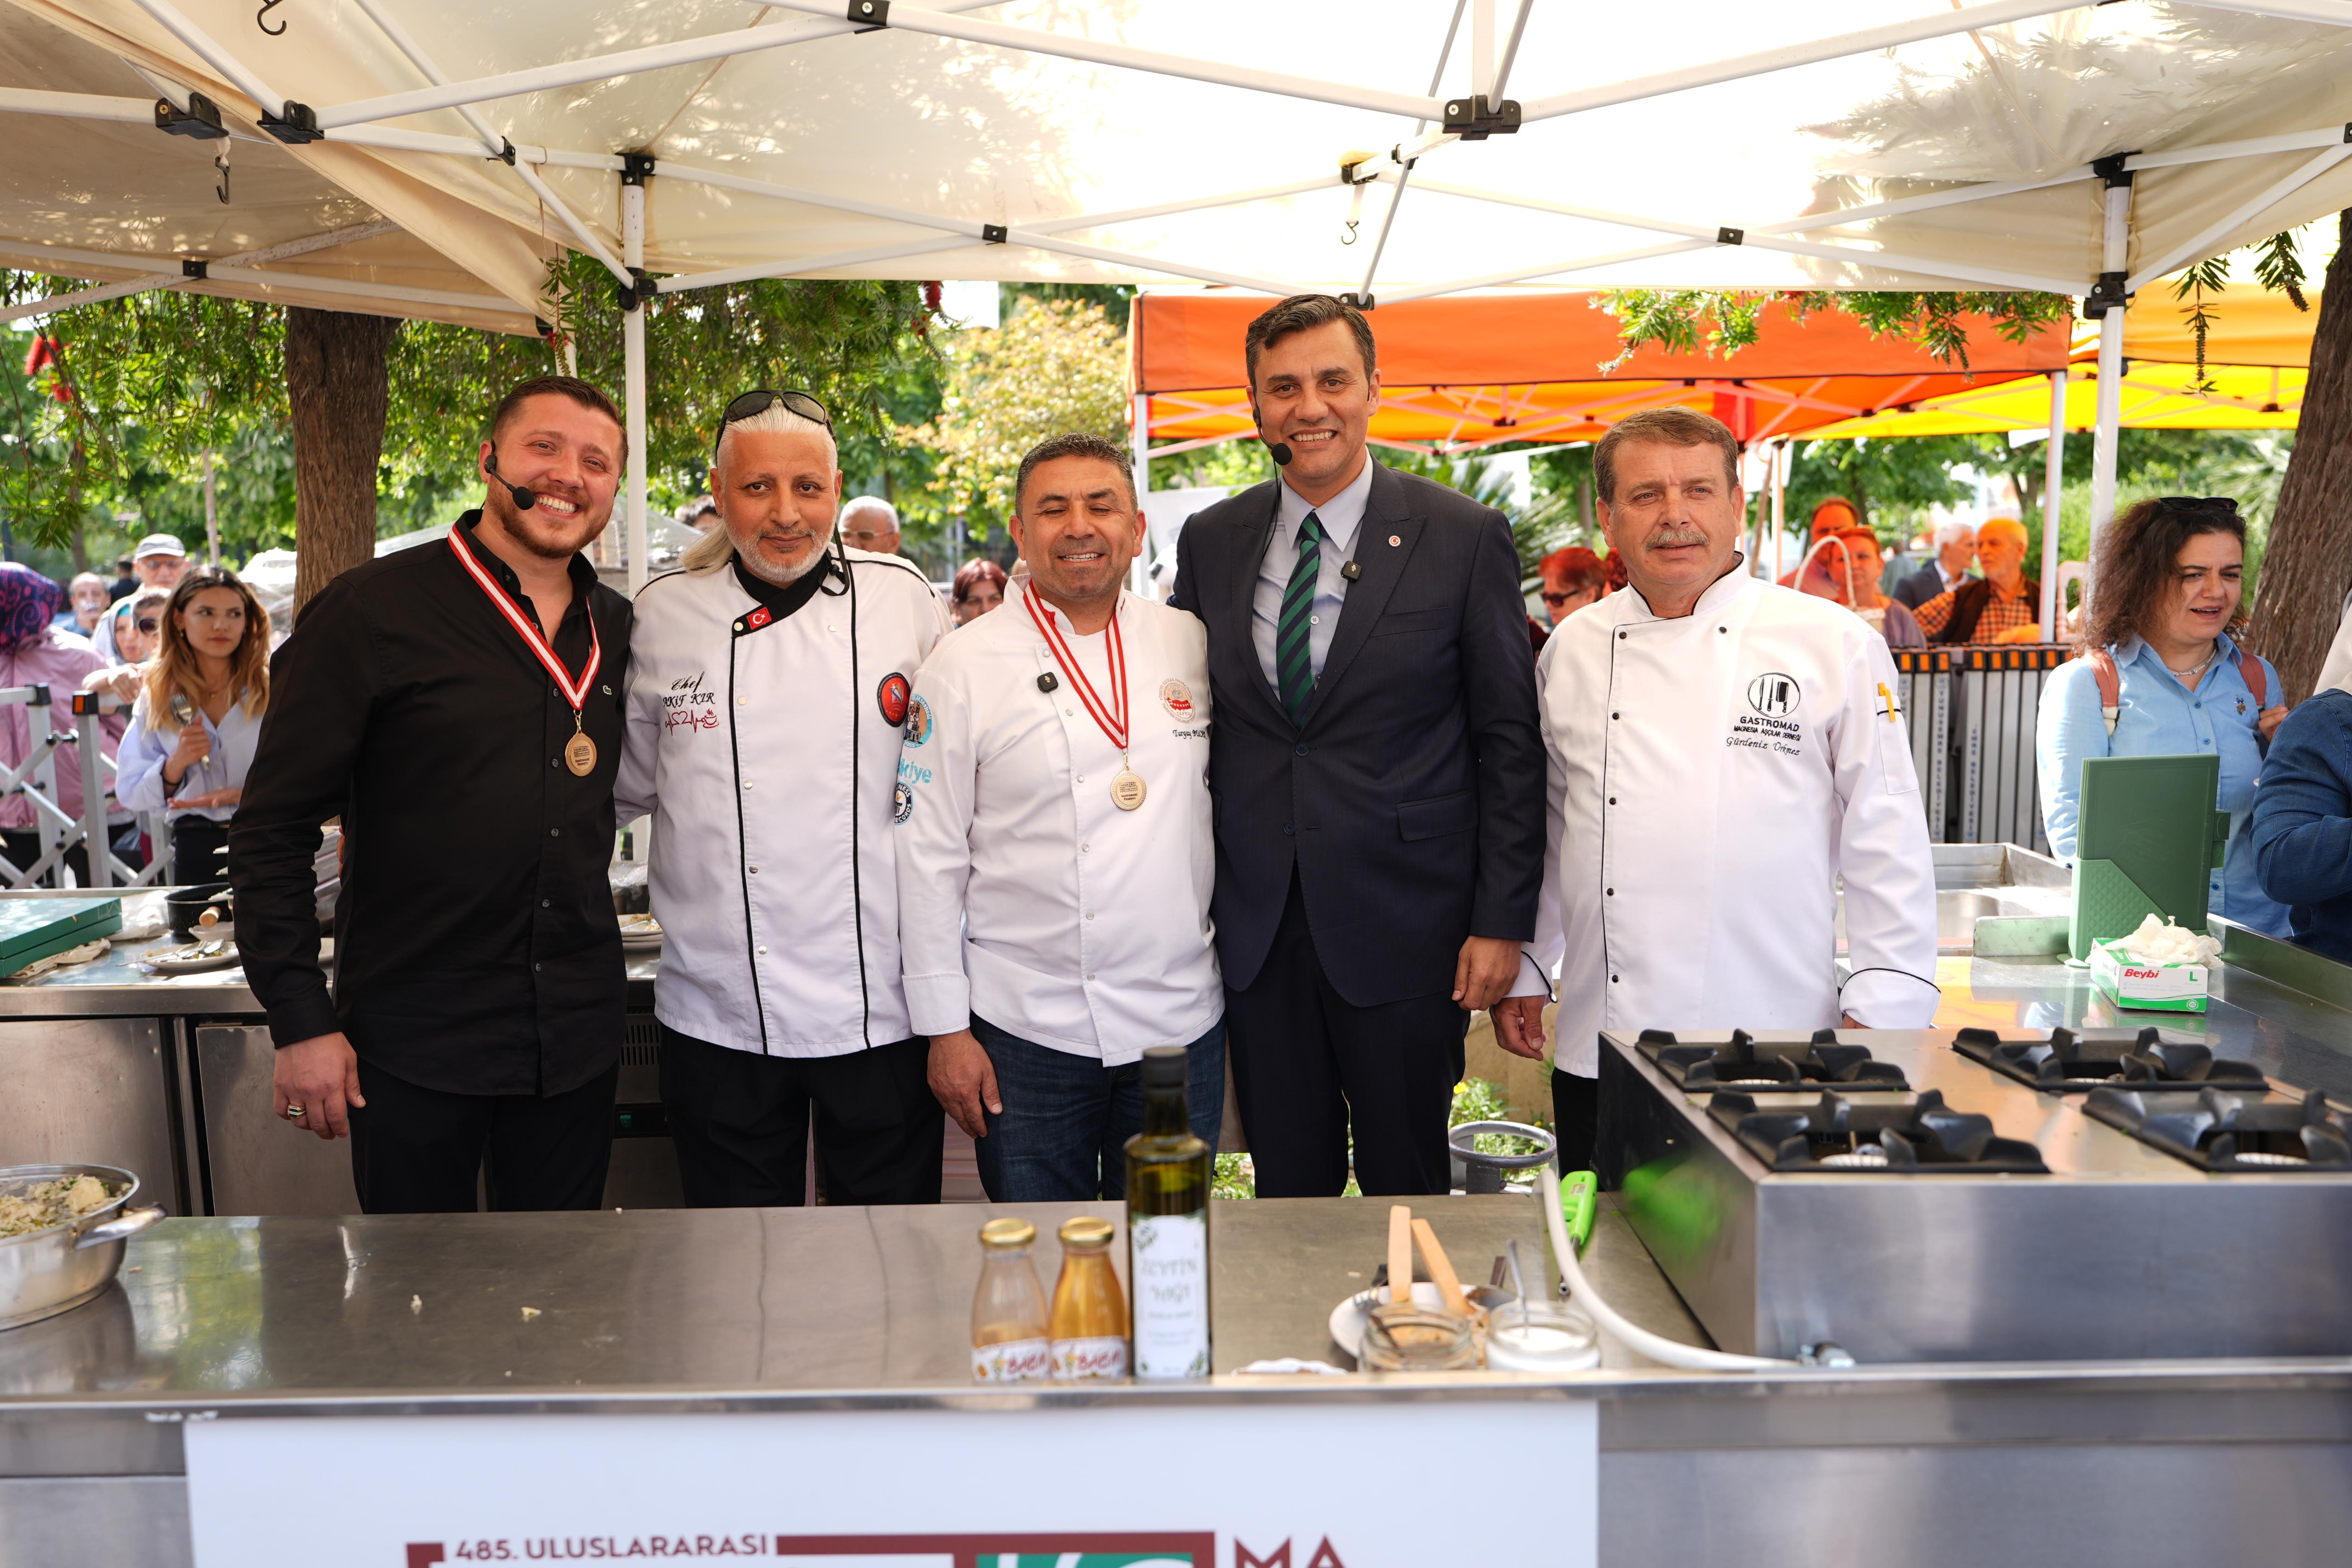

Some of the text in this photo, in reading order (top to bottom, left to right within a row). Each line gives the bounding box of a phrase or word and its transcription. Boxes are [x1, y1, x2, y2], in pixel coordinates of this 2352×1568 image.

[671, 671, 705, 693] Chef
[690, 692, 715, 704] KIR
[1740, 716, 1799, 731] GASTROMAD
[1173, 730, 1192, 739] Turgay
[1726, 737, 1768, 749] Gürdeniz
[899, 759, 932, 784] kiye
[897, 784, 911, 798] NESS
[2124, 969, 2198, 982] Beybi L
[456, 1534, 767, 1561] 485. ULUSLARARASI
